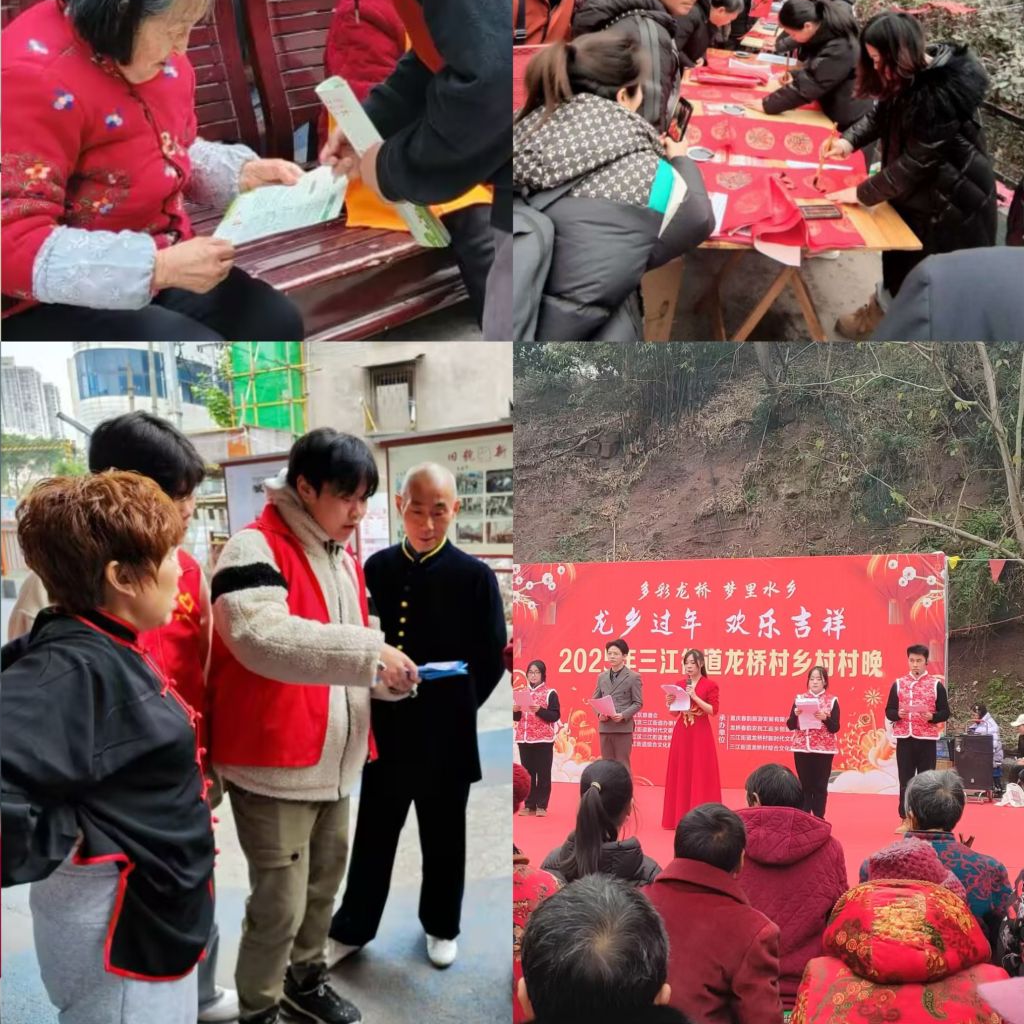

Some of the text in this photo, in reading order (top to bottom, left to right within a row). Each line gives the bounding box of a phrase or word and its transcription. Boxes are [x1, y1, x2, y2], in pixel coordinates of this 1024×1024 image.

[637, 578, 798, 601] 多彩龙桥 梦里水乡
[591, 605, 847, 641] 龙乡过年 欢乐吉祥
